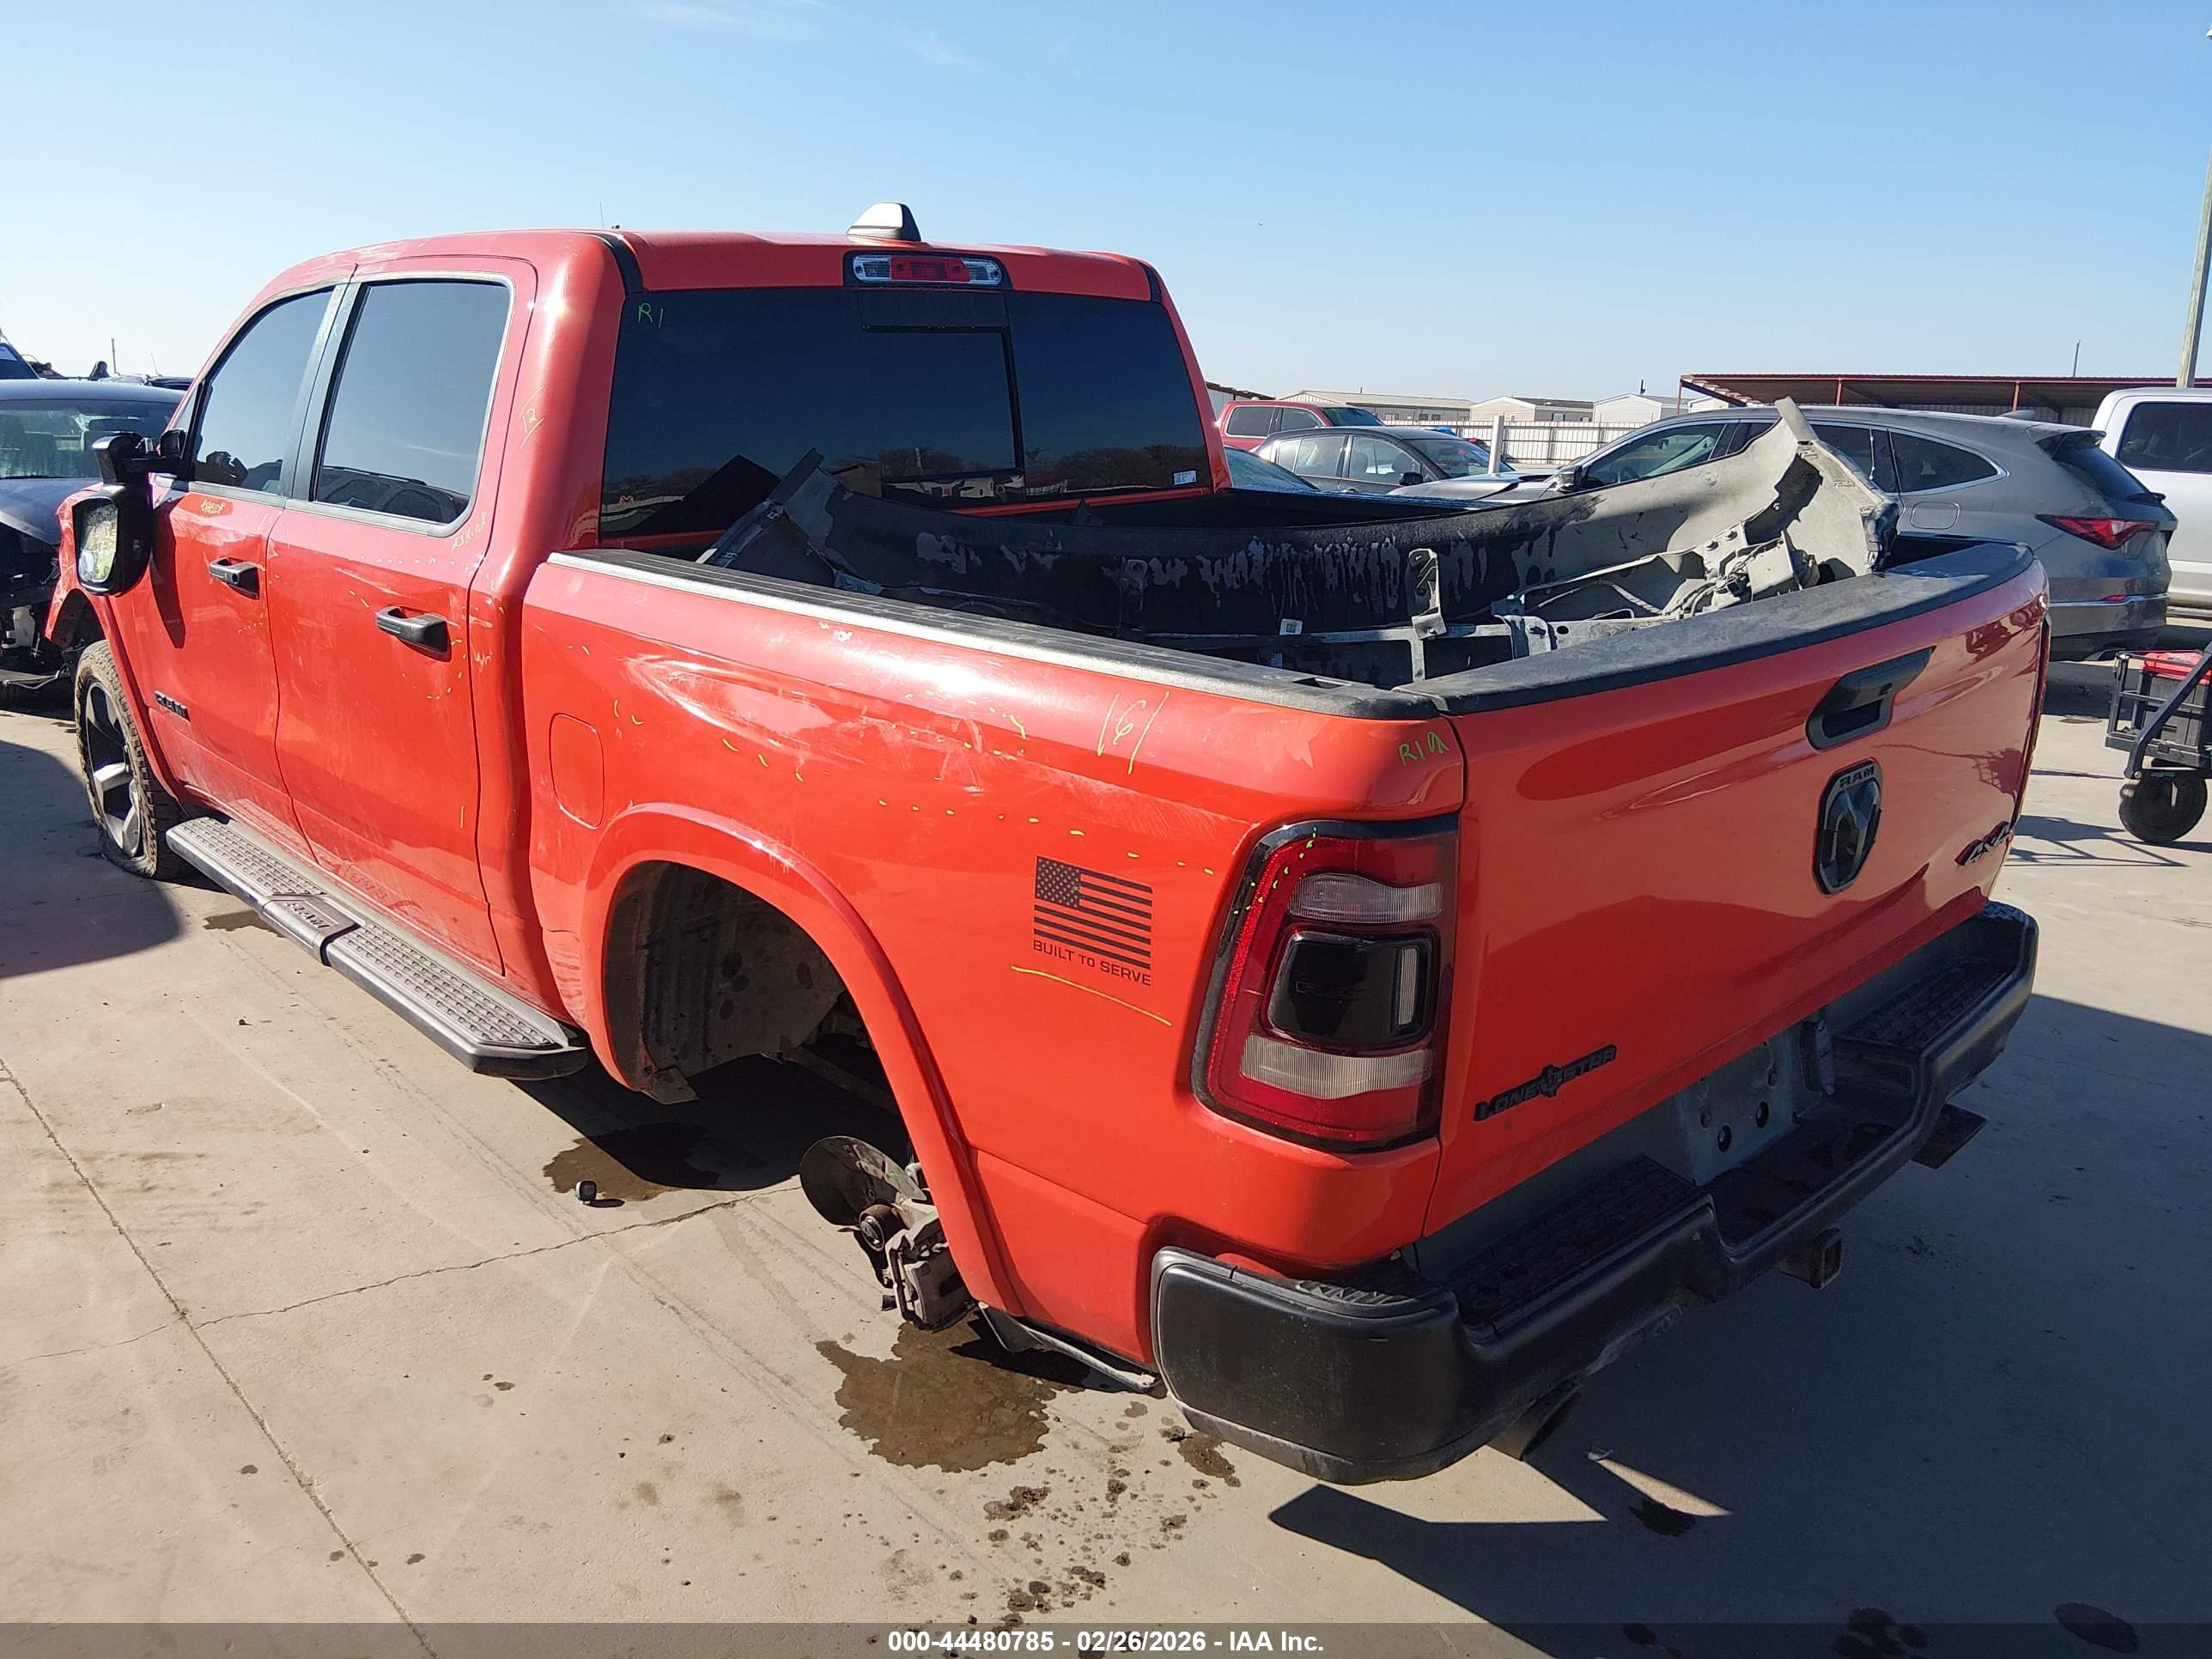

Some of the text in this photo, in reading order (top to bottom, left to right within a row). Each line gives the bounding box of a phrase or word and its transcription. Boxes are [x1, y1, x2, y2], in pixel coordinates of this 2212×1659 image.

[1839, 764, 1875, 788] RAM
[1033, 939, 1151, 987] BUILT TO SERVE
[1473, 1044, 1617, 1122] LONE STAR
